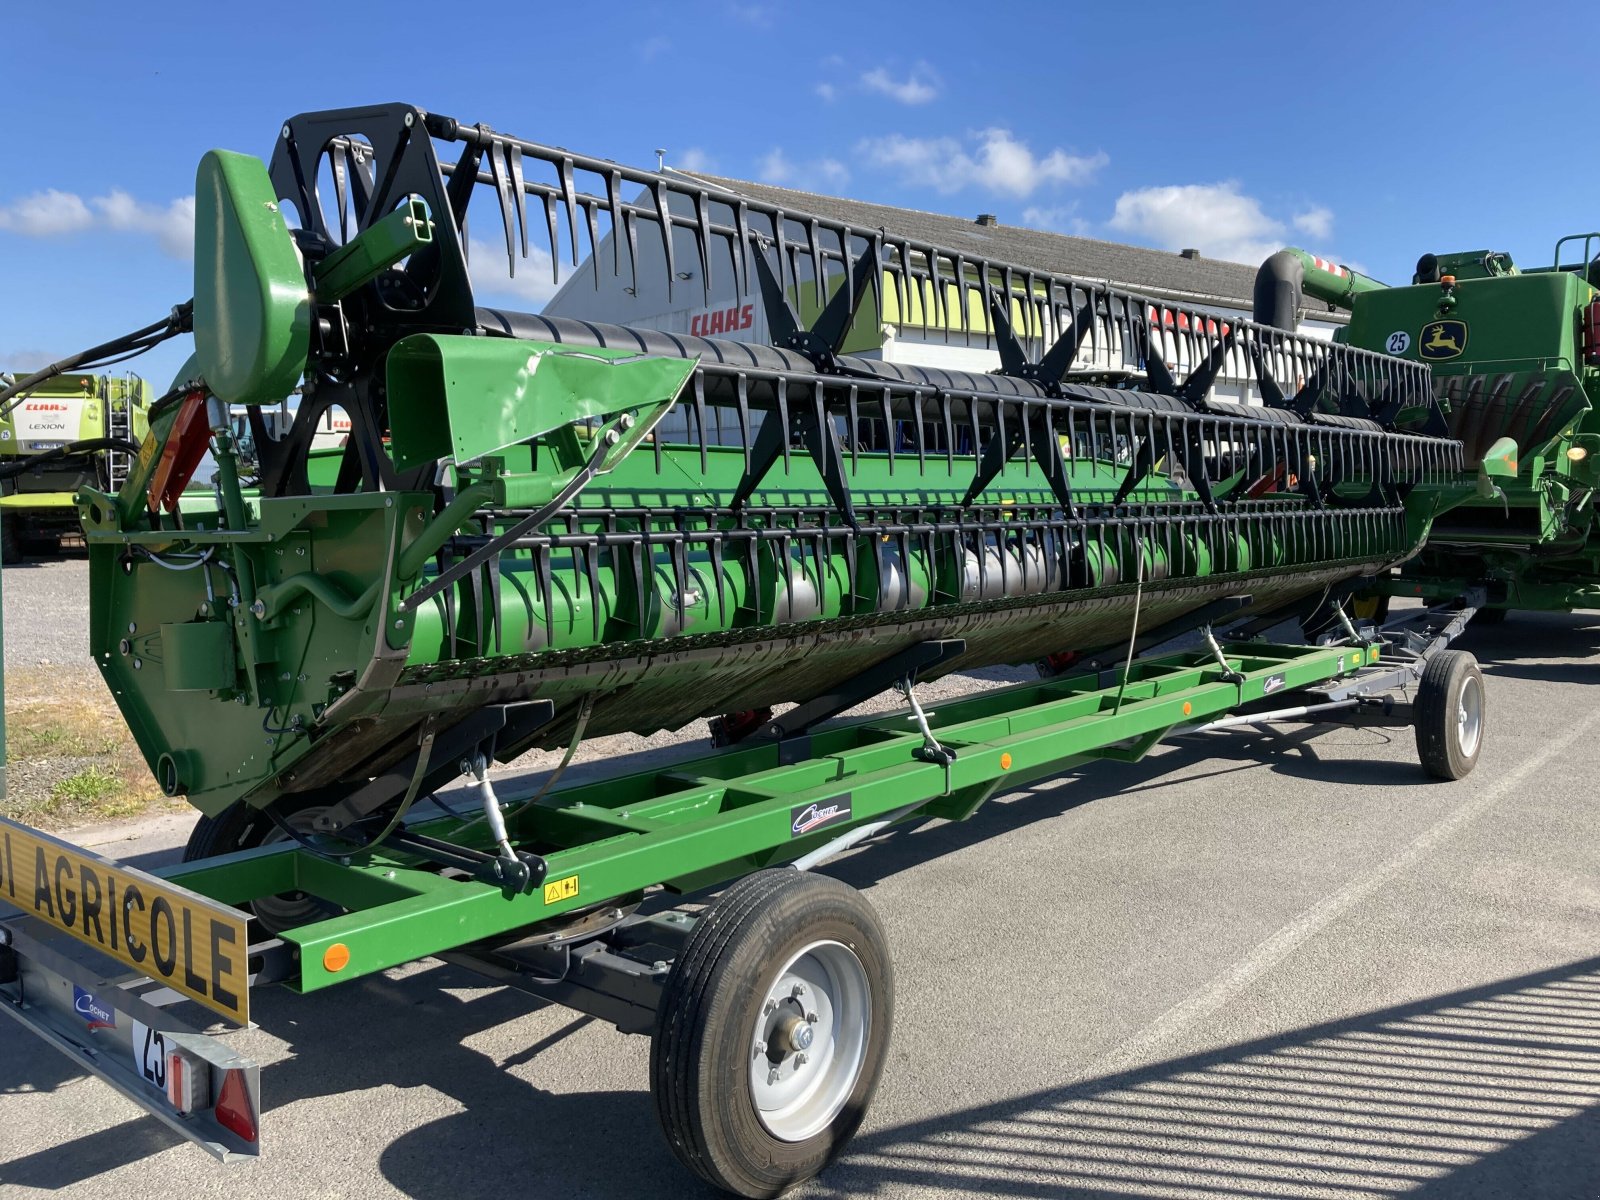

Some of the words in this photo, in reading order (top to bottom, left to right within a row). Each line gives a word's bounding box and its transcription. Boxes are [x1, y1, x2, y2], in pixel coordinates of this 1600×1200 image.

[690, 304, 754, 337] CLAAS
[1390, 333, 1406, 352] 25
[25, 403, 68, 411] CLAAS
[34, 846, 238, 1012] AGRICOLE
[75, 994, 110, 1022] COCHET
[143, 1026, 165, 1088] 25
